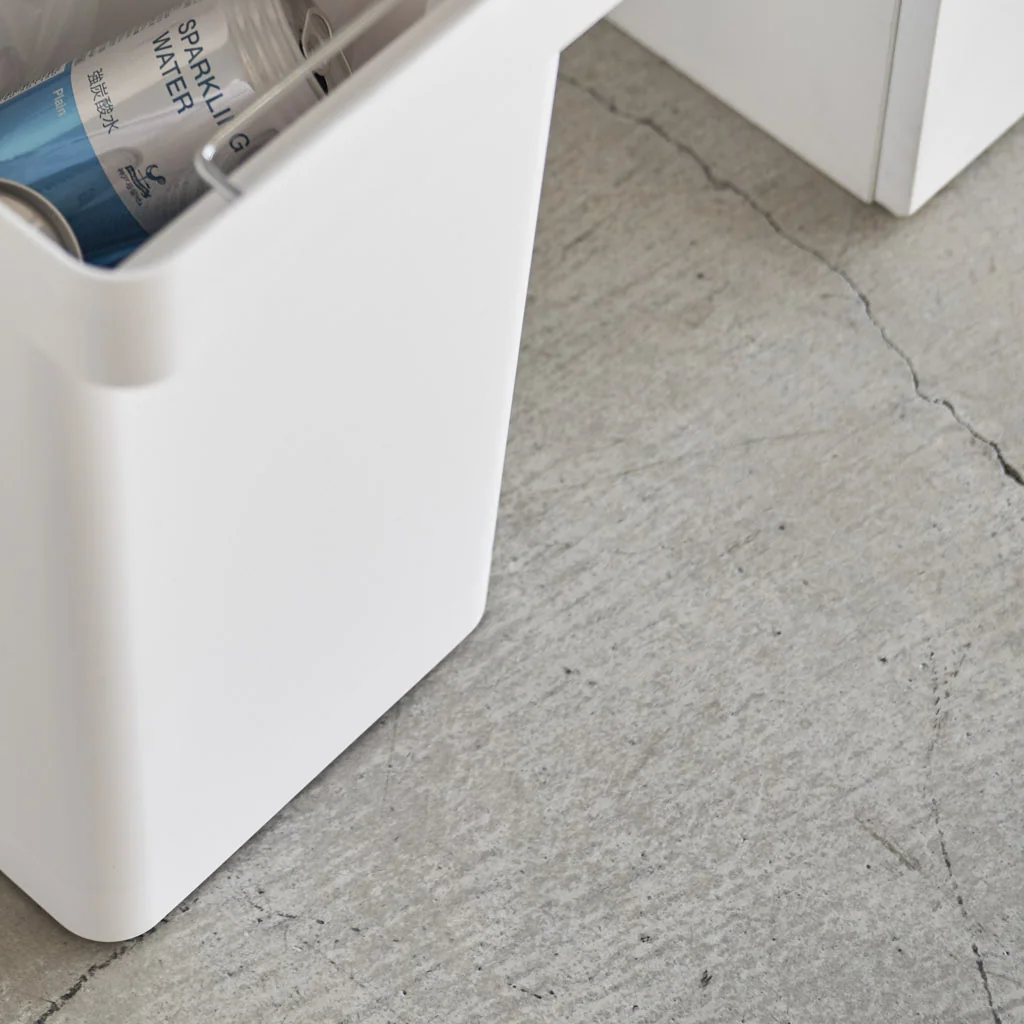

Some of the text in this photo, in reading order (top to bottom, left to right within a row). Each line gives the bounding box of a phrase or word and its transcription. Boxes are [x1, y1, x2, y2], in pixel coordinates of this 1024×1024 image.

[52, 87, 67, 118] Plain
[87, 68, 119, 134] 強炭酸水
[152, 30, 194, 114] WATER
[178, 18, 250, 152] SPARKLIG
